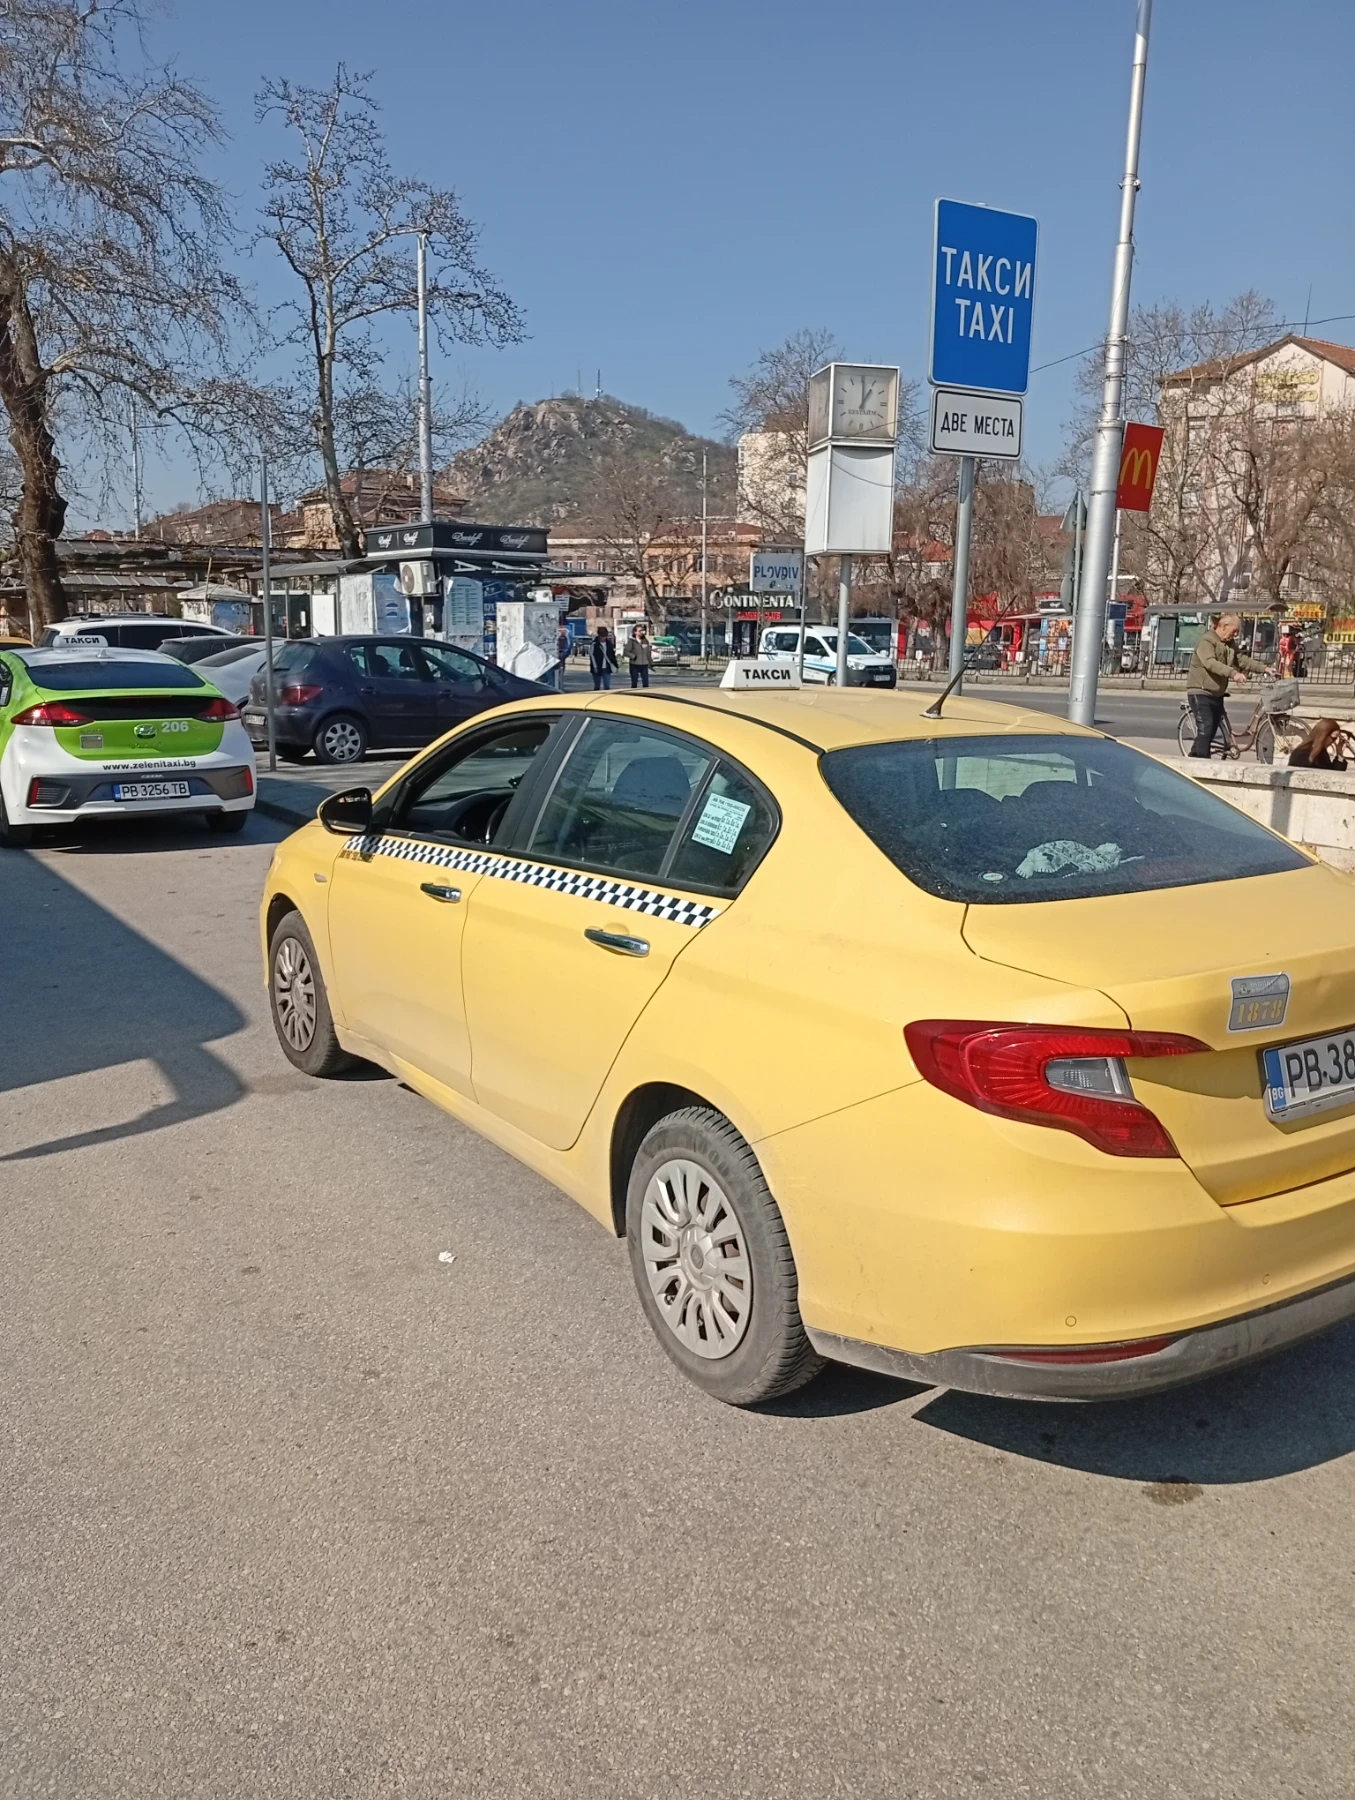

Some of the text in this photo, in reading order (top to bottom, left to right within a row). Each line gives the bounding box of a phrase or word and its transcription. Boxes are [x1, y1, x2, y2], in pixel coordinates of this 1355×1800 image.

[941, 246, 1031, 299] ТАКСИ
[955, 298, 1014, 344] TAXI
[940, 411, 1015, 438] ДВЕ МЕСТА
[754, 565, 799, 579] PLOVDIV
[743, 669, 791, 680] ТАКСИ
[161, 721, 189, 732] 206
[102, 759, 197, 771] www.zelenitaxi.bg
[122, 785, 139, 797] PB
[141, 784, 169, 796] 3256
[171, 783, 187, 794] TB
[1237, 1000, 1283, 1023] 1878
[1272, 1086, 1284, 1099] BG
